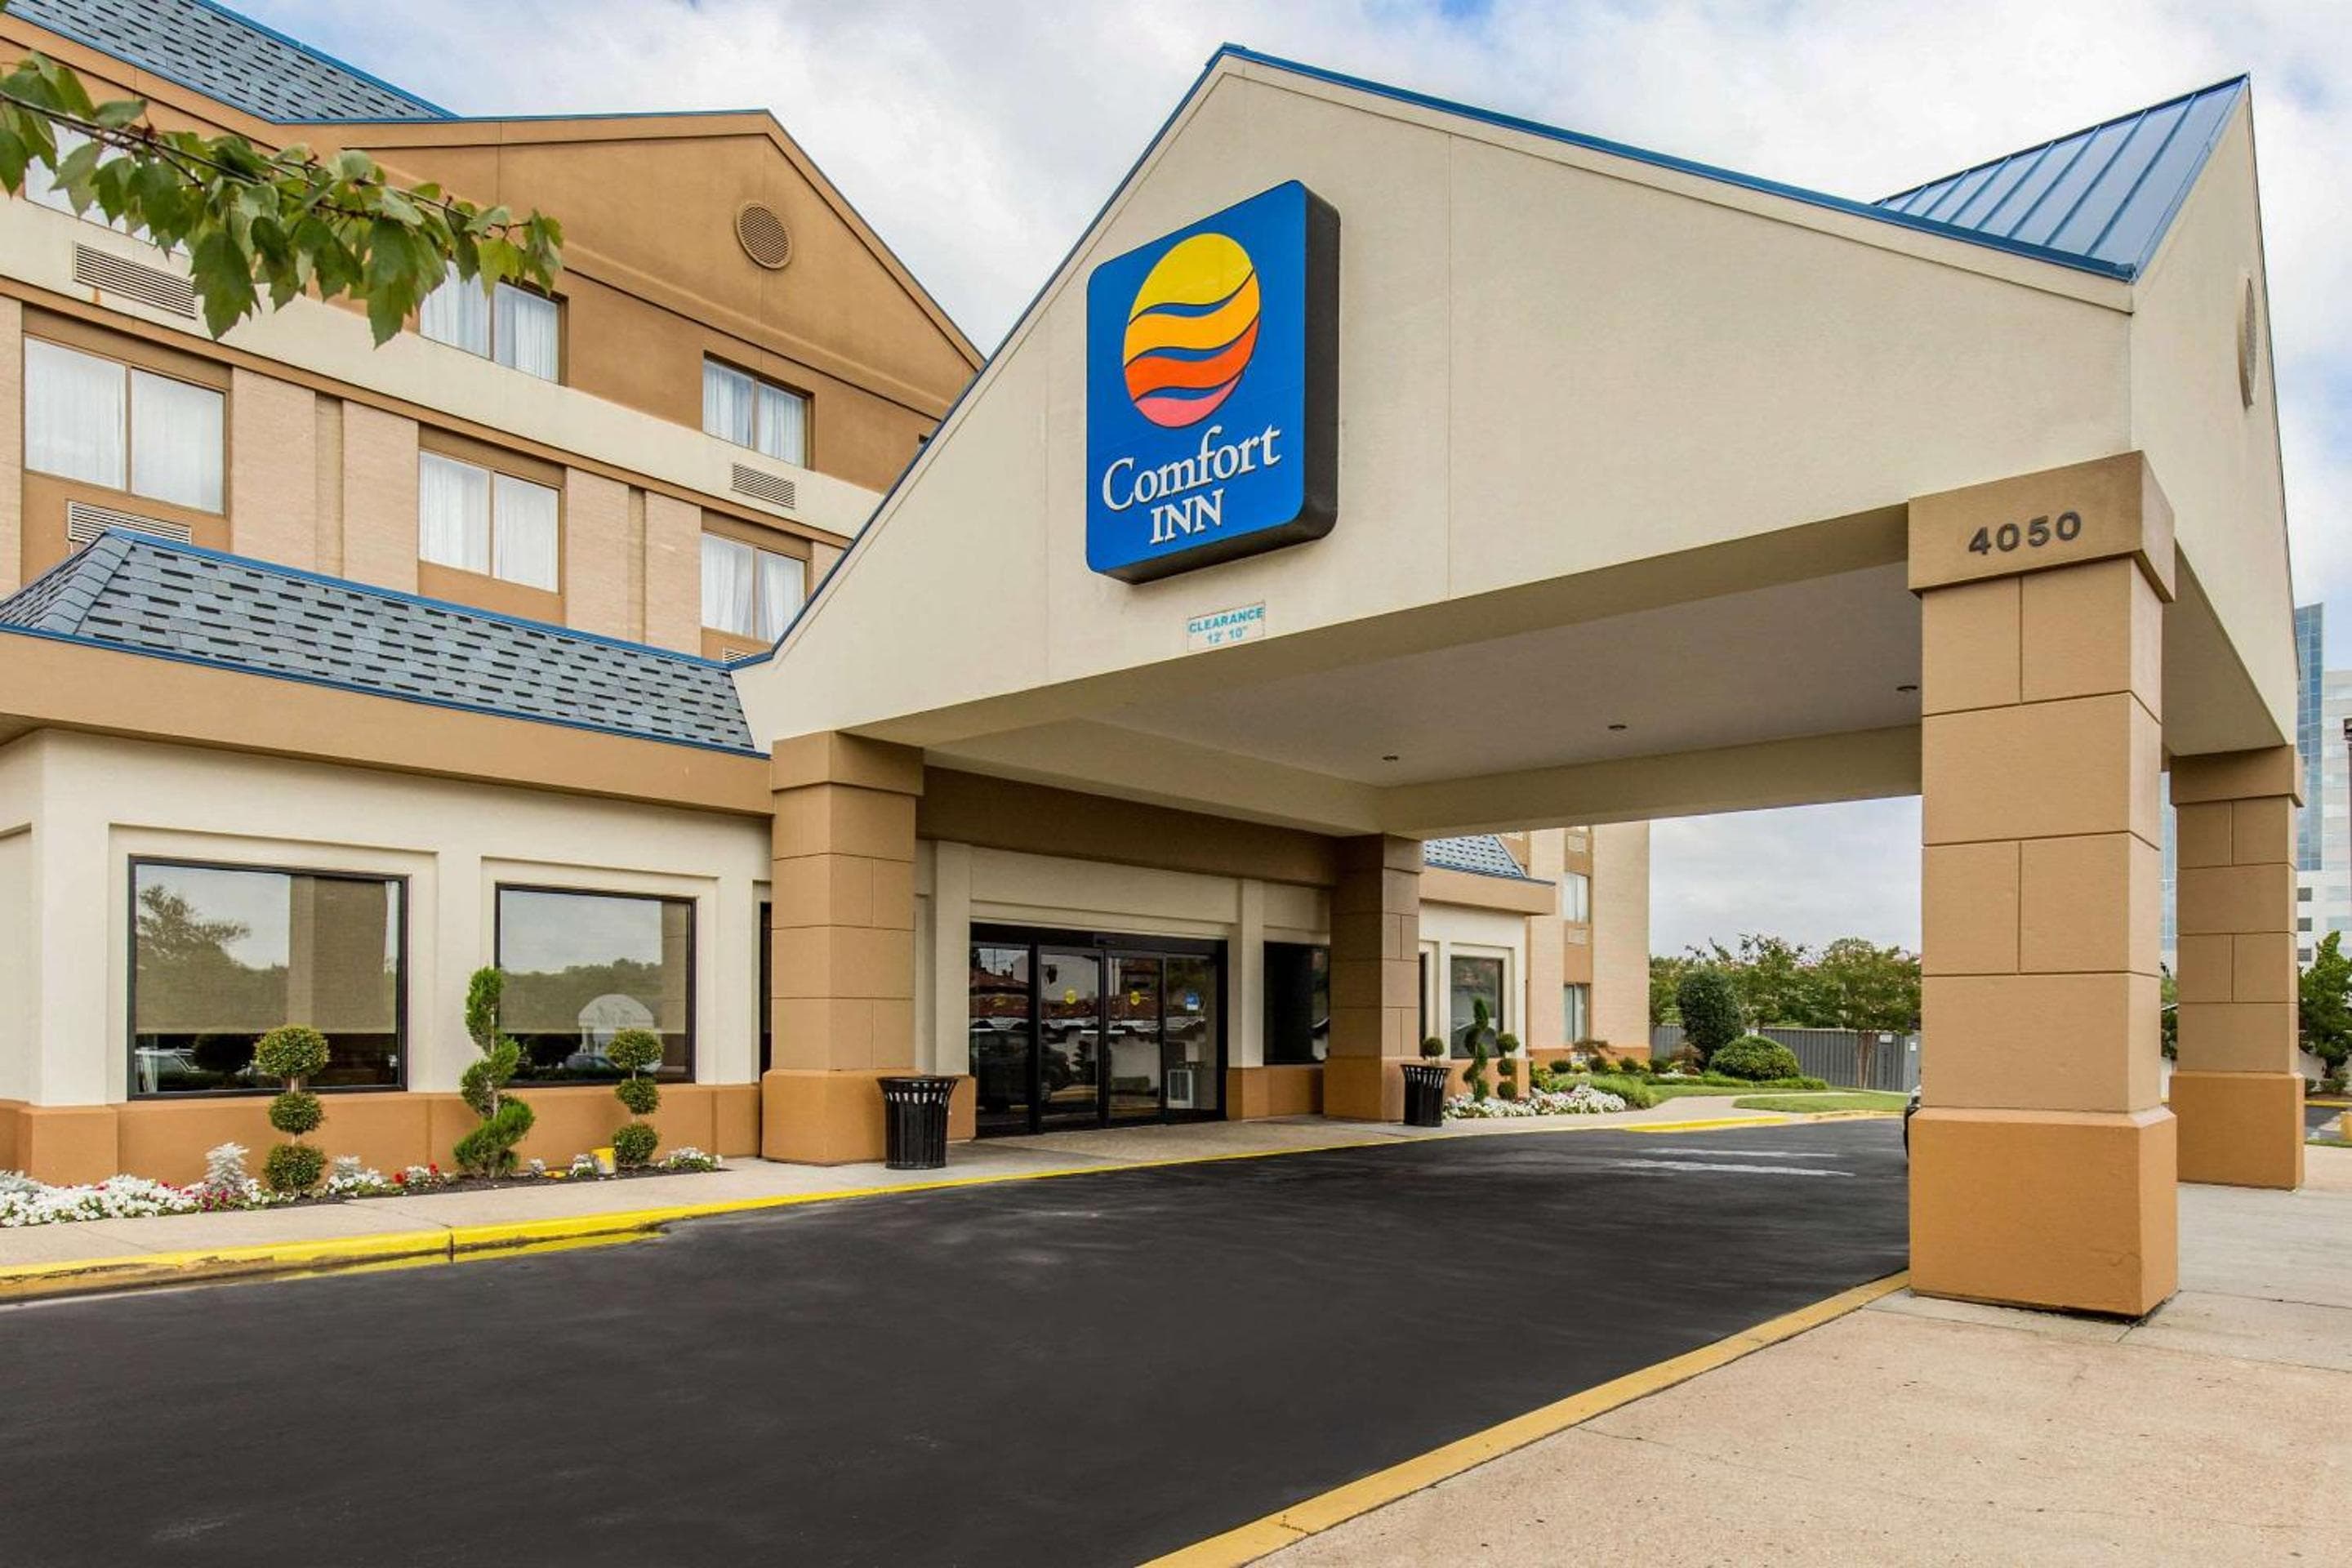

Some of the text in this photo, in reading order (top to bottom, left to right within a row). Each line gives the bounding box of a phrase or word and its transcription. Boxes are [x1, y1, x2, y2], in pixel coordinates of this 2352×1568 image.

[1102, 424, 1281, 511] Comfort
[1149, 488, 1224, 545] INN
[1968, 511, 2082, 555] 4050
[1189, 607, 1263, 633] CLEARANCE
